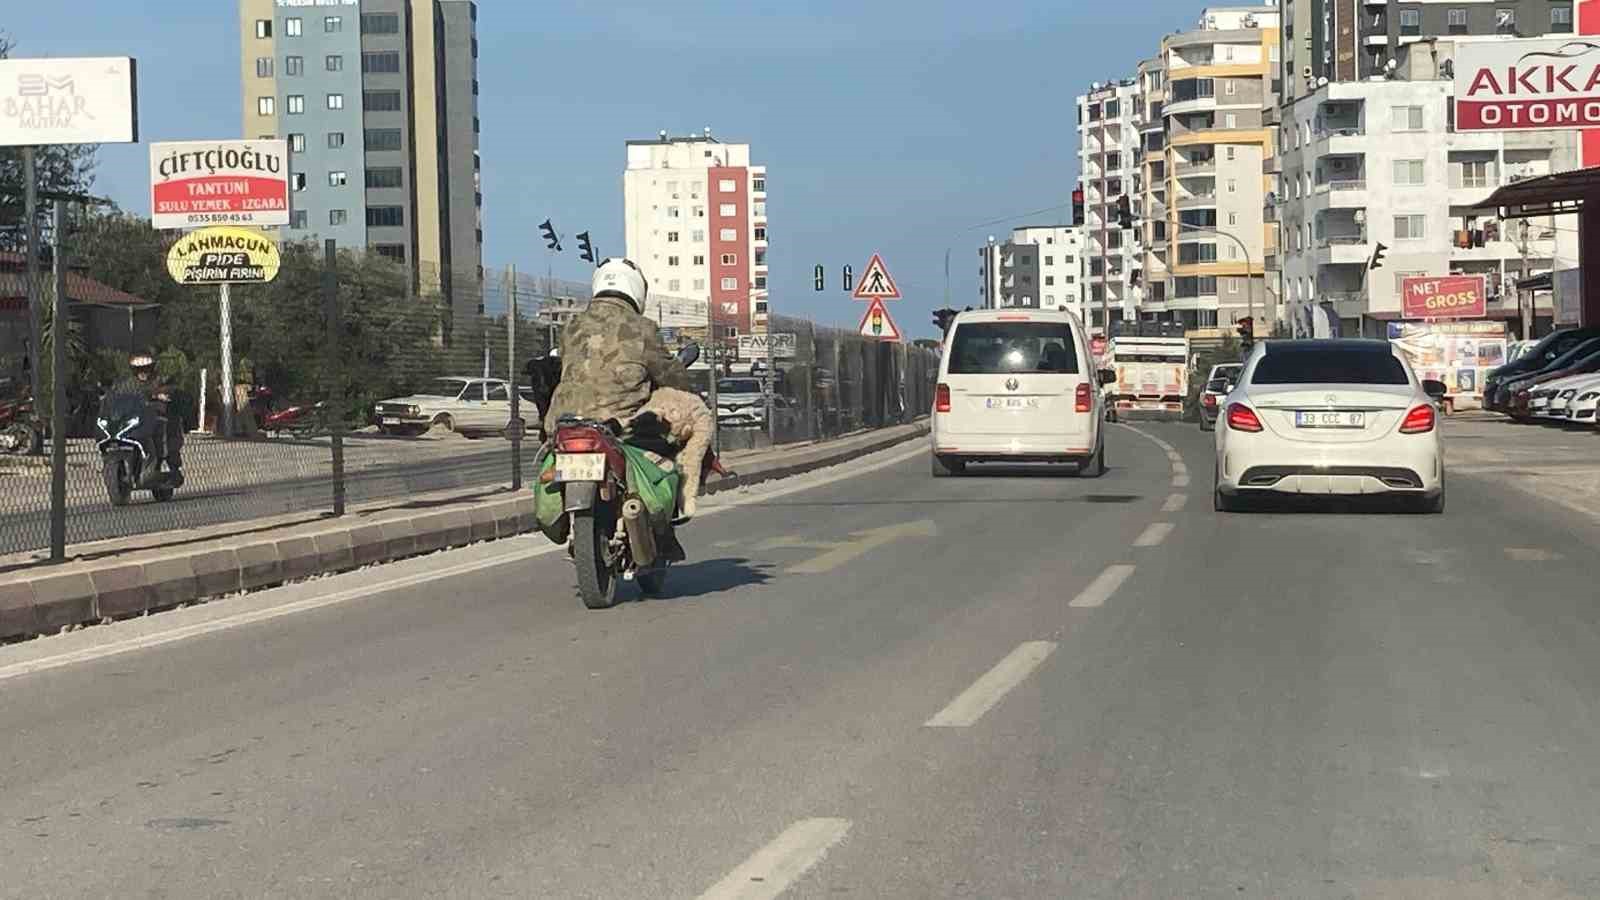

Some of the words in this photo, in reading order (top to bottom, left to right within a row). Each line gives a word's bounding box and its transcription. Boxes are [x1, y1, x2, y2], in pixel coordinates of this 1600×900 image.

[4, 95, 96, 120] BAHAR
[1481, 103, 1600, 124] OTOMO
[18, 116, 77, 129] MUTFAK
[159, 145, 280, 181] ÇİFTÇİOĞLU
[187, 179, 250, 195] TANTUNİ
[159, 201, 188, 212] SULU
[191, 199, 231, 210] YEMEK
[177, 236, 270, 257] LAHMACUN
[1411, 280, 1441, 295] NET
[1425, 290, 1477, 309] GROSS
